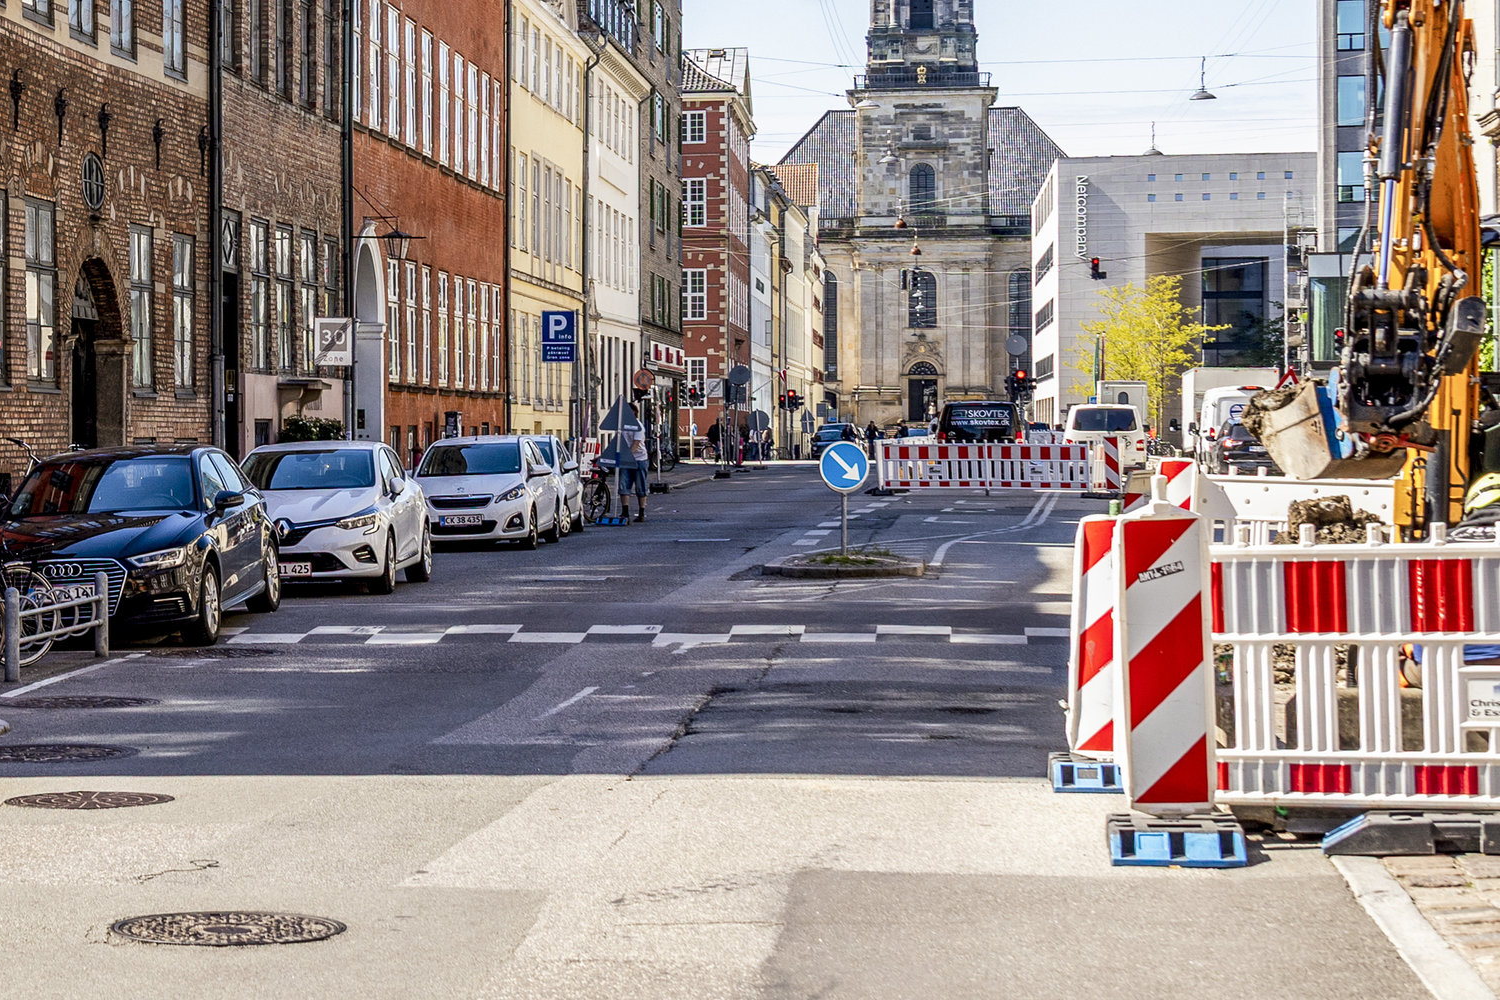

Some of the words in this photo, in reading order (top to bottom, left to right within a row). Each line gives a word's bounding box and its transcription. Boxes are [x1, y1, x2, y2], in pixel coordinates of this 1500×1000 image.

[1074, 175, 1088, 260] Netcompany
[549, 314, 567, 339] P
[322, 329, 345, 345] 30
[968, 410, 1010, 418] SKOVTEX
[445, 516, 455, 524] CK
[467, 515, 480, 523] 435
[291, 564, 310, 574] 425
